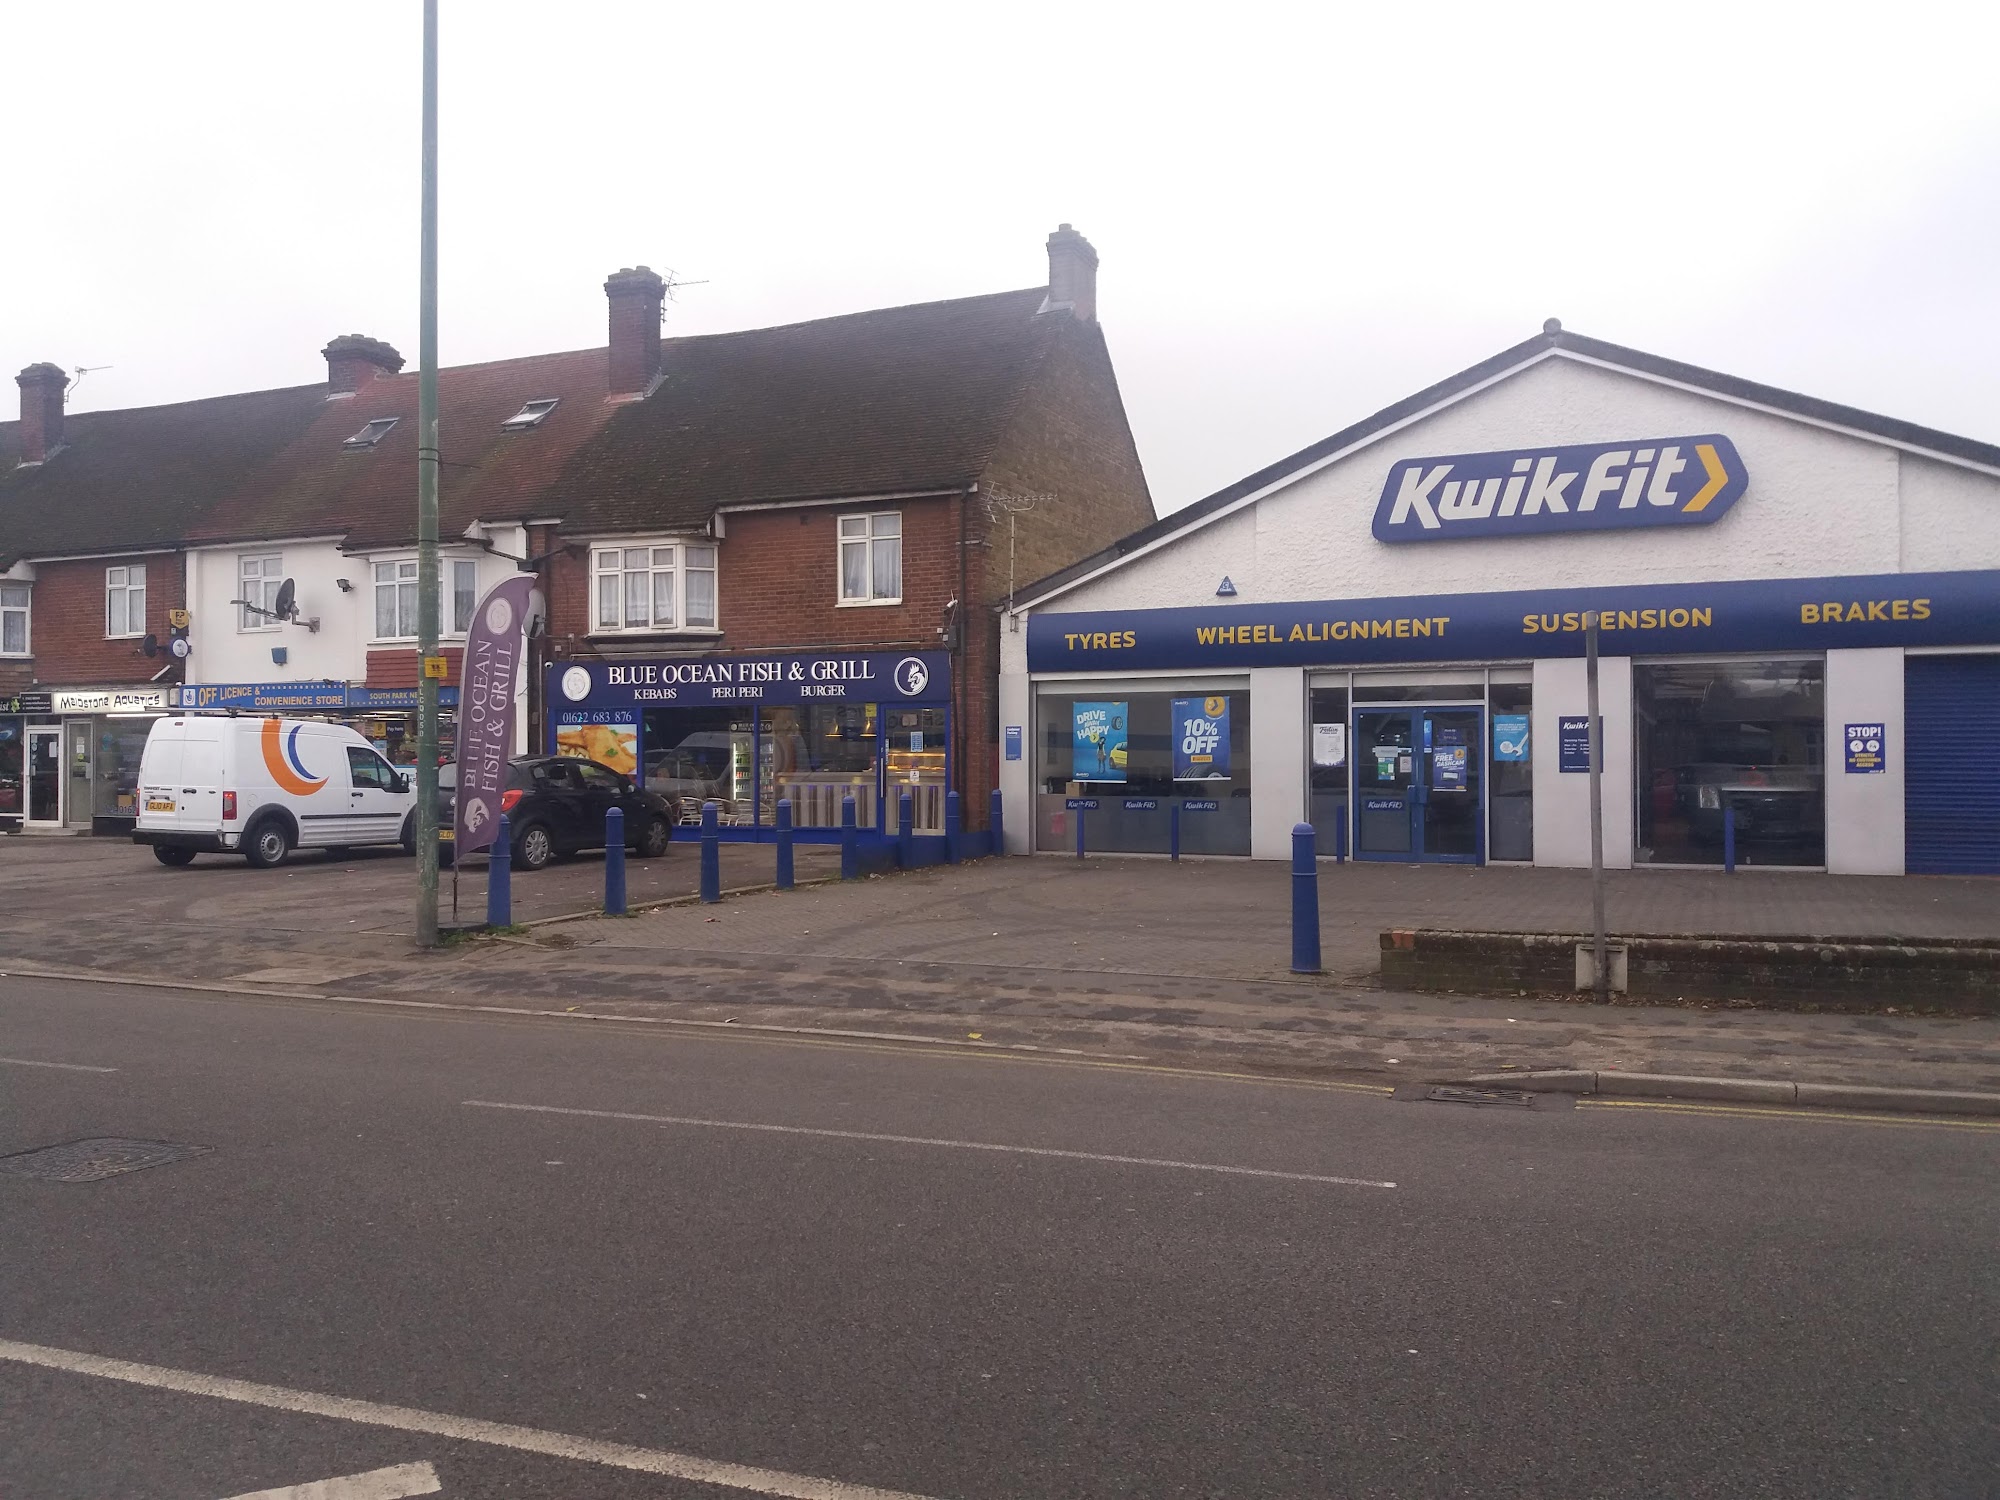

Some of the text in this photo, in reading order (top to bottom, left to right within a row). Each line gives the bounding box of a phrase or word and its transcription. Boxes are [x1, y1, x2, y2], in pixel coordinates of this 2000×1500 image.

[1800, 598, 1931, 625] BRAKES
[1522, 607, 1713, 634] SUSPENSION
[1196, 617, 1450, 646] WHEEL ALIGNMENT
[1064, 630, 1137, 650] TYRES
[608, 659, 876, 685] BLUE OCEAN FISH & GRILL
[471, 640, 492, 723] OCEAN
[199, 686, 261, 707] OFF LICENCE &
[369, 692, 391, 700] SOUTH
[409, 691, 418, 699] NE
[634, 688, 677, 700] KEBABS
[712, 687, 764, 698] PERI PERI
[800, 685, 846, 697] BURGER
[254, 695, 344, 706] CONVENIENCE STORE
[482, 642, 513, 793] FISH & GRILL
[562, 711, 632, 723] 01622 683 876
[1076, 709, 1106, 724] DRIVE
[1077, 725, 1109, 740] HAPPY
[1183, 718, 1218, 736] 10%
[1848, 726, 1882, 737] STOP!
[1435, 754, 1453, 762] FREE
